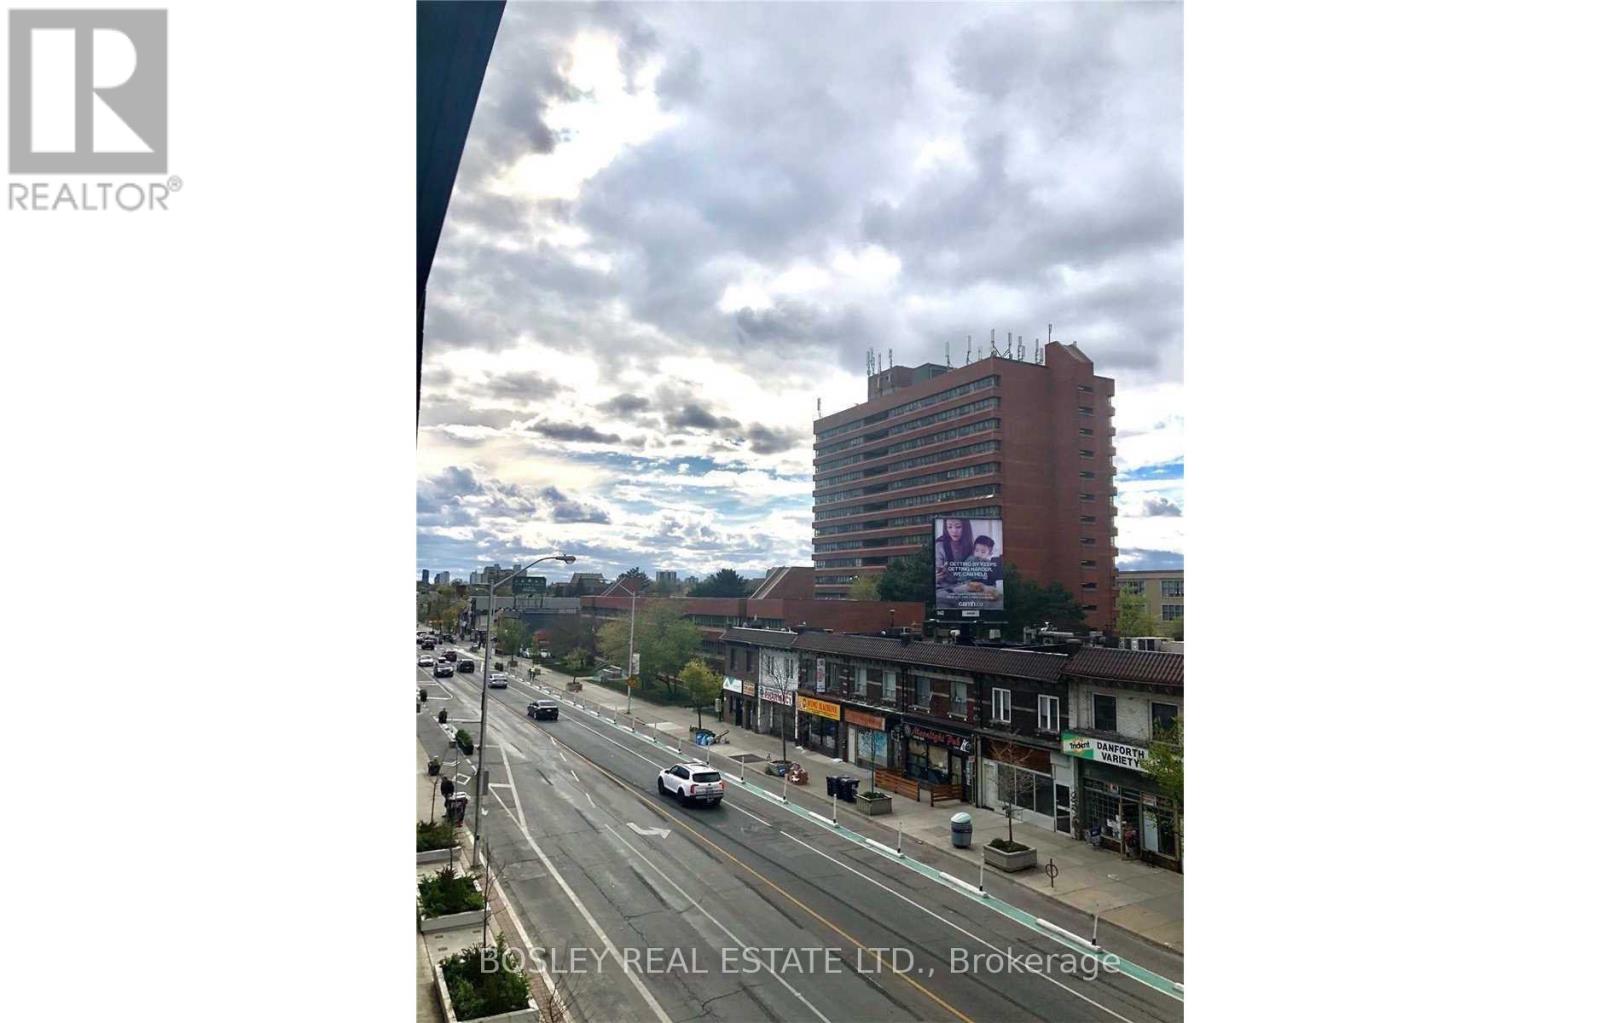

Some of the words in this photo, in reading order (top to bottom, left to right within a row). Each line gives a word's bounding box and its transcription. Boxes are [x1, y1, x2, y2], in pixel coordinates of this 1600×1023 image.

[1069, 740, 1090, 750] Trident
[1096, 741, 1145, 759] DANFORTH
[1101, 752, 1140, 768] VARIETY
